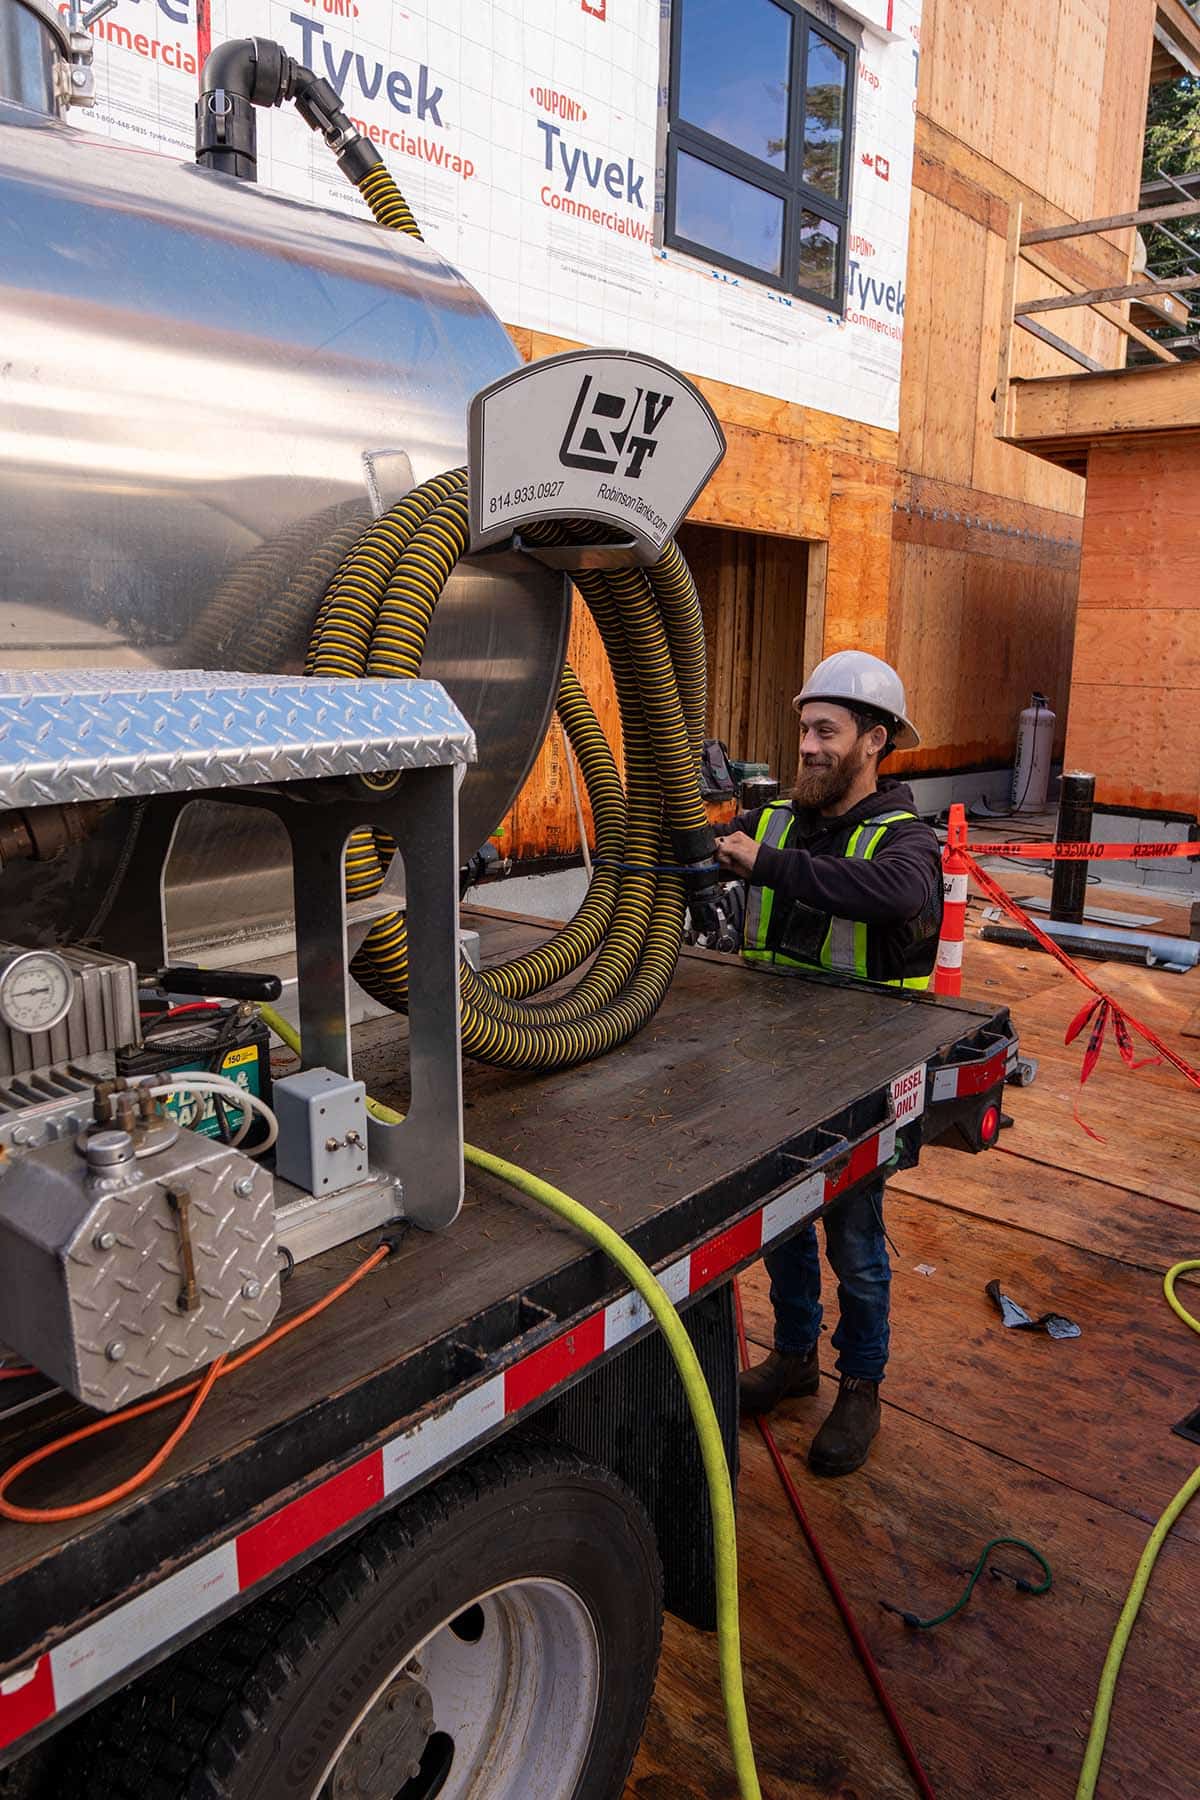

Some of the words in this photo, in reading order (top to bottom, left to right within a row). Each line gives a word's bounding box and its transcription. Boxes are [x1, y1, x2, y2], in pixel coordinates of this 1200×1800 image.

[290, 12, 444, 127] Tyvek
[536, 87, 582, 122] DUPONT
[350, 116, 475, 180] mercialWrap
[537, 119, 645, 209] Tyvek
[540, 186, 655, 247] CommercialWra
[489, 481, 565, 513] 814.933.0927
[596, 483, 668, 535] RobinsonTanks.com
[894, 1070, 922, 1100] DIESEL
[896, 1091, 918, 1119] ONLY
